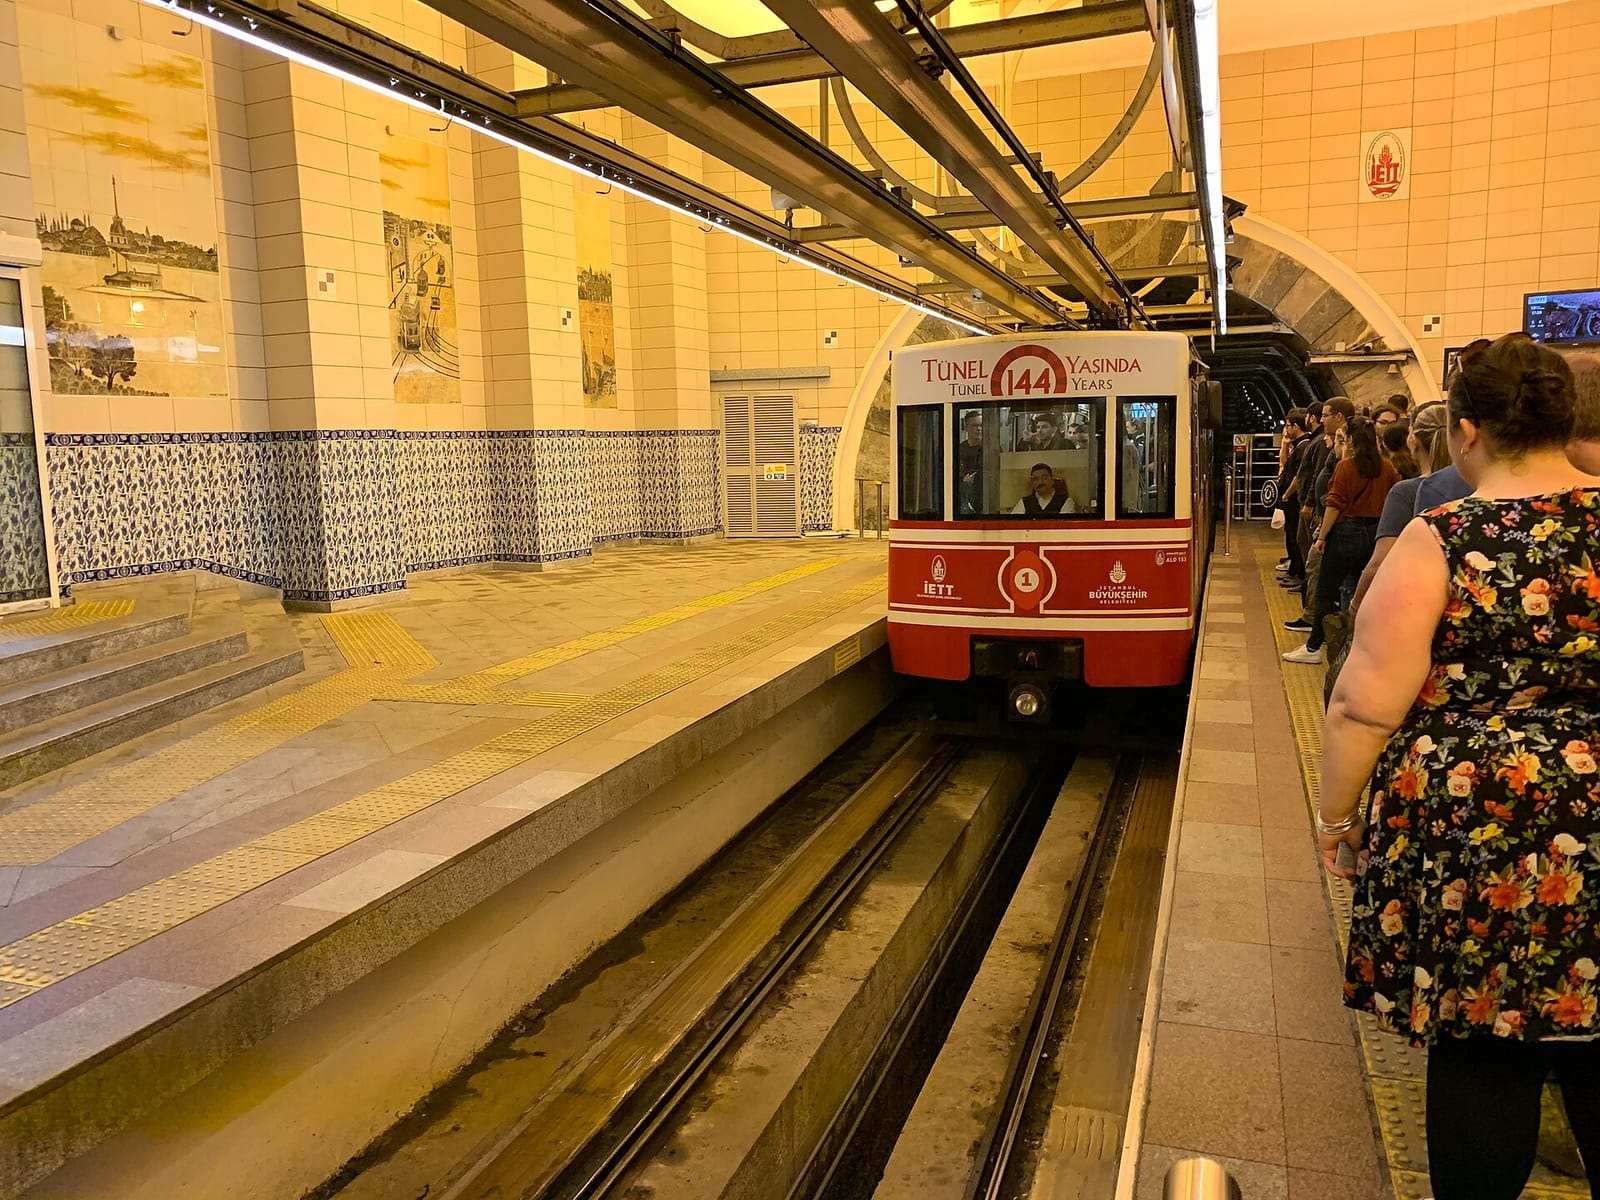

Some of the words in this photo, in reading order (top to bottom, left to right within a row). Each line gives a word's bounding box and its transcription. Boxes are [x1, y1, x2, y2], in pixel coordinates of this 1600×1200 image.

[921, 358, 989, 382] TÜNEL
[1007, 368, 1051, 396] 144
[1066, 356, 1142, 375] YAŞINDA
[948, 383, 988, 397] TÜNEL
[1071, 378, 1113, 391] YEARS
[1021, 572, 1032, 587] 1
[924, 580, 954, 595] İETT
[1089, 588, 1148, 600] BÜYÜKŞEHİR
